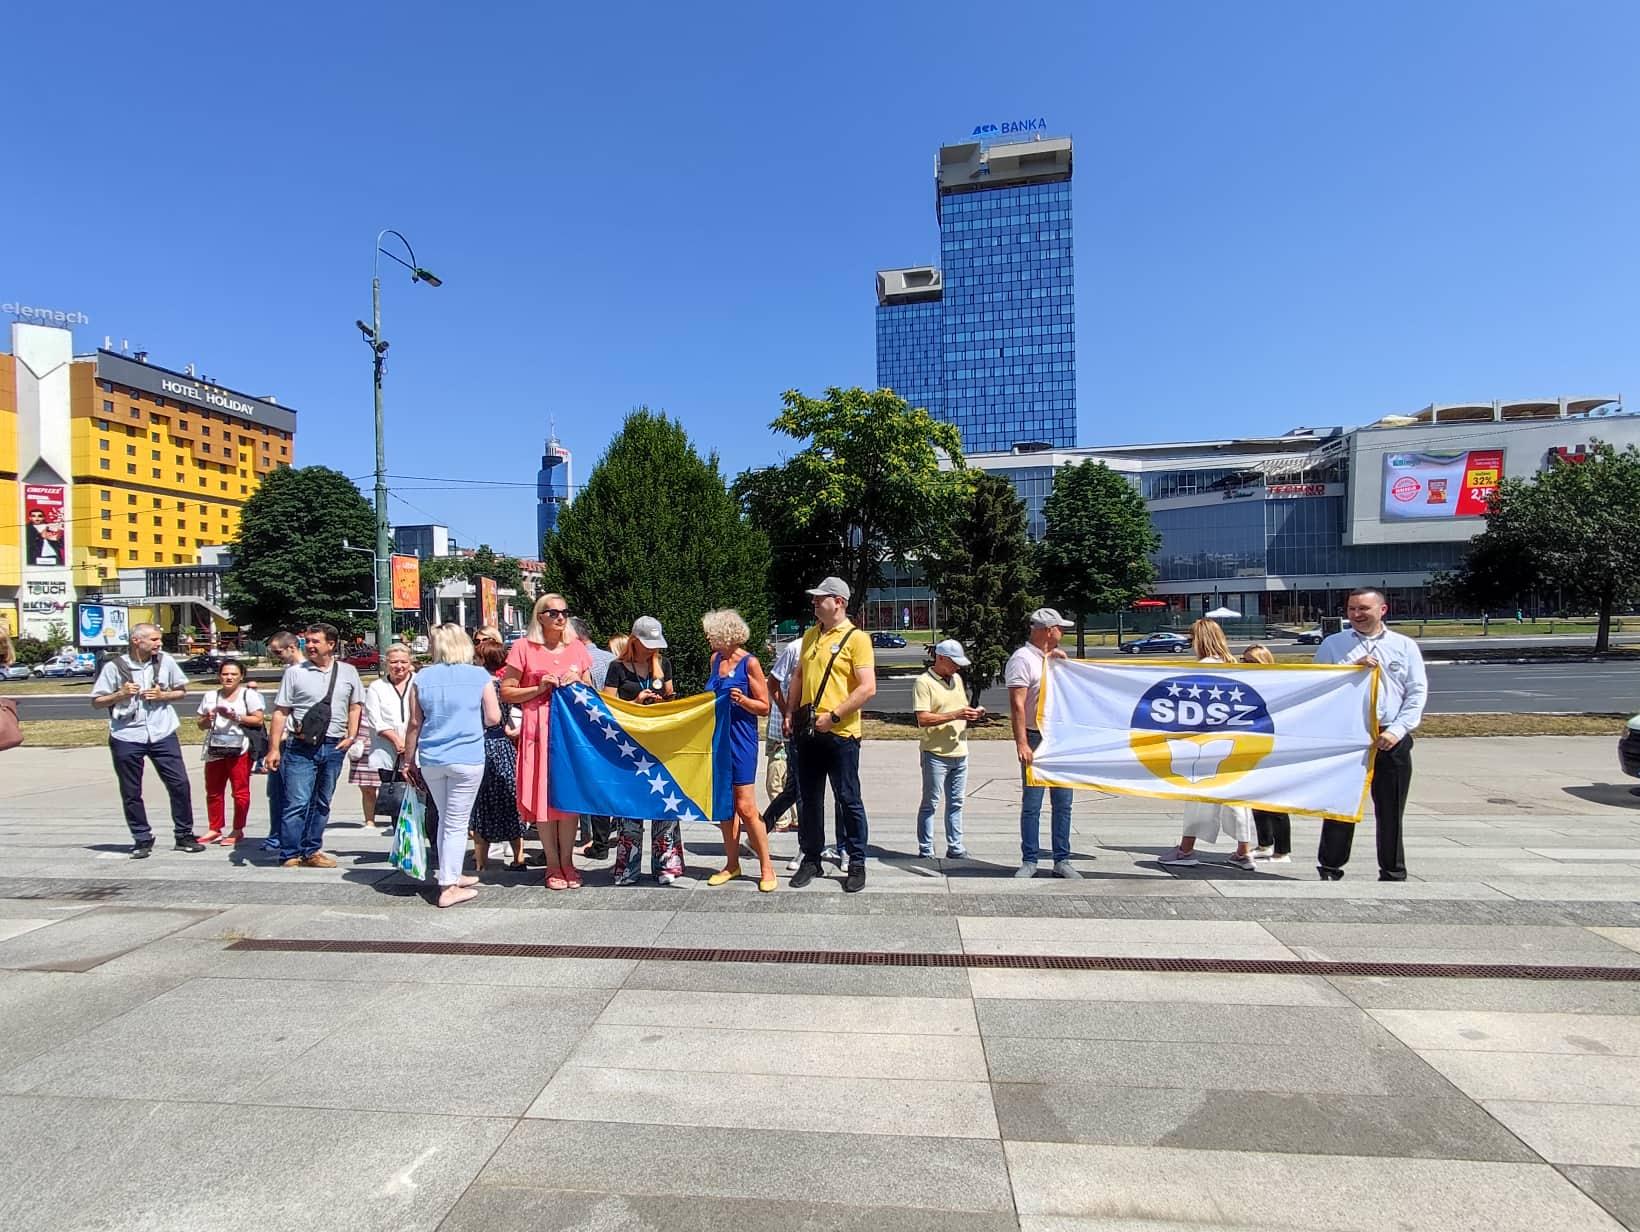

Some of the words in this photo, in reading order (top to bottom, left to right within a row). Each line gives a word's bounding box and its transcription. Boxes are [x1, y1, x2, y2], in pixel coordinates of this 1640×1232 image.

[1001, 118, 1047, 134] BANKA
[162, 379, 202, 401] HOTEL
[206, 392, 254, 415] HOLIDAY
[28, 585, 66, 595] TOUCH
[1150, 698, 1258, 726] SDSZ
